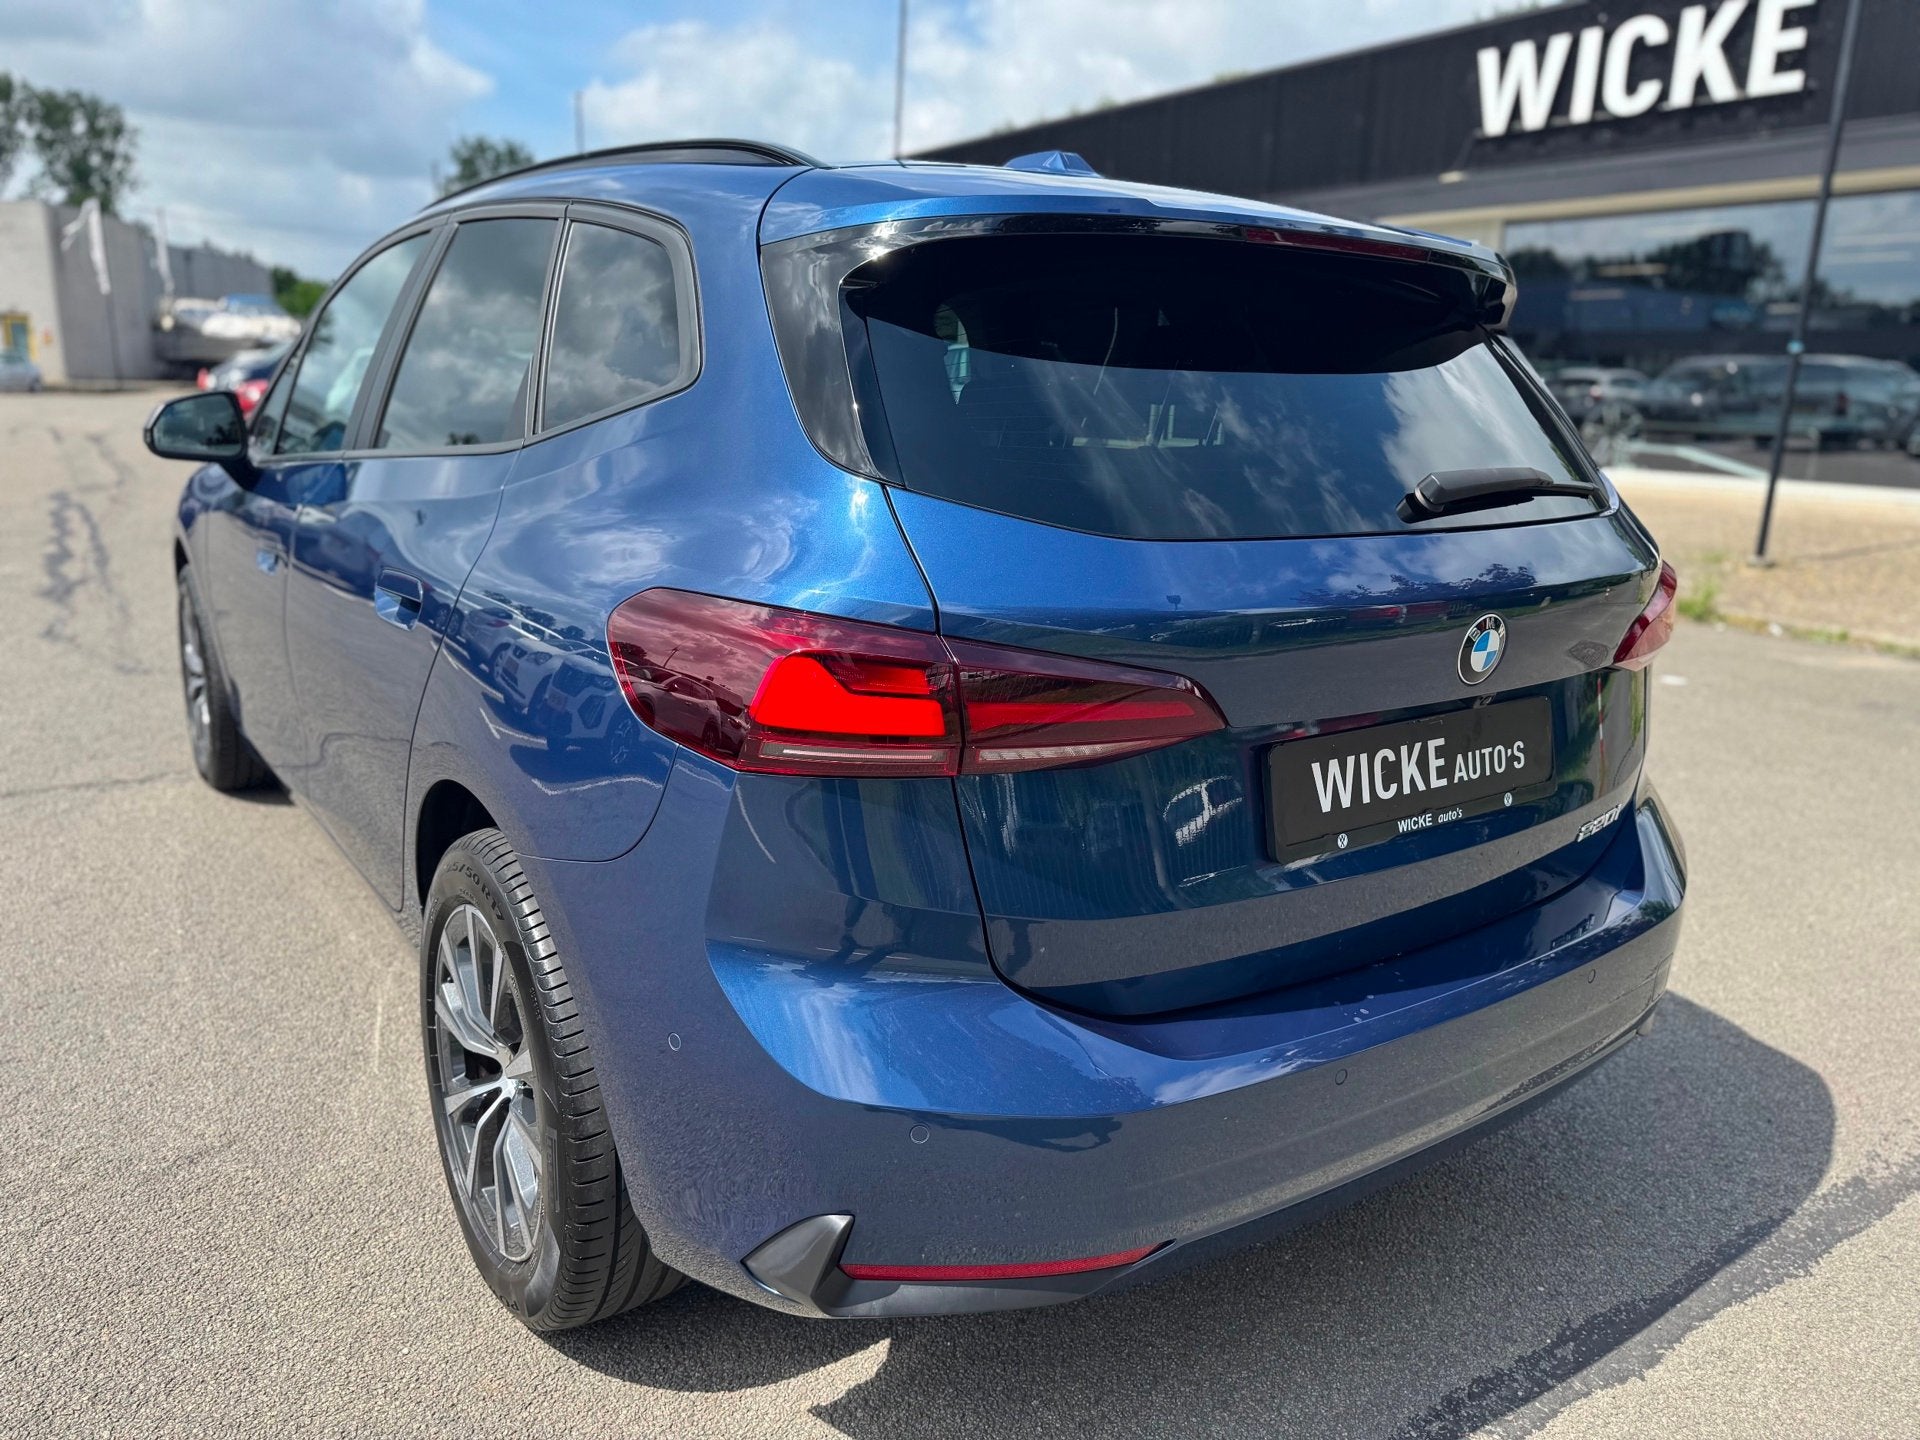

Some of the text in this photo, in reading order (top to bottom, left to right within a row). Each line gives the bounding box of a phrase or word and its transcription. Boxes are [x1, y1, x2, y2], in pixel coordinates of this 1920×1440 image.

[1477, 0, 1814, 137] WICKE
[1311, 738, 1526, 813] WICKE AUTO'S
[1397, 808, 1463, 833] WICKE auto's
